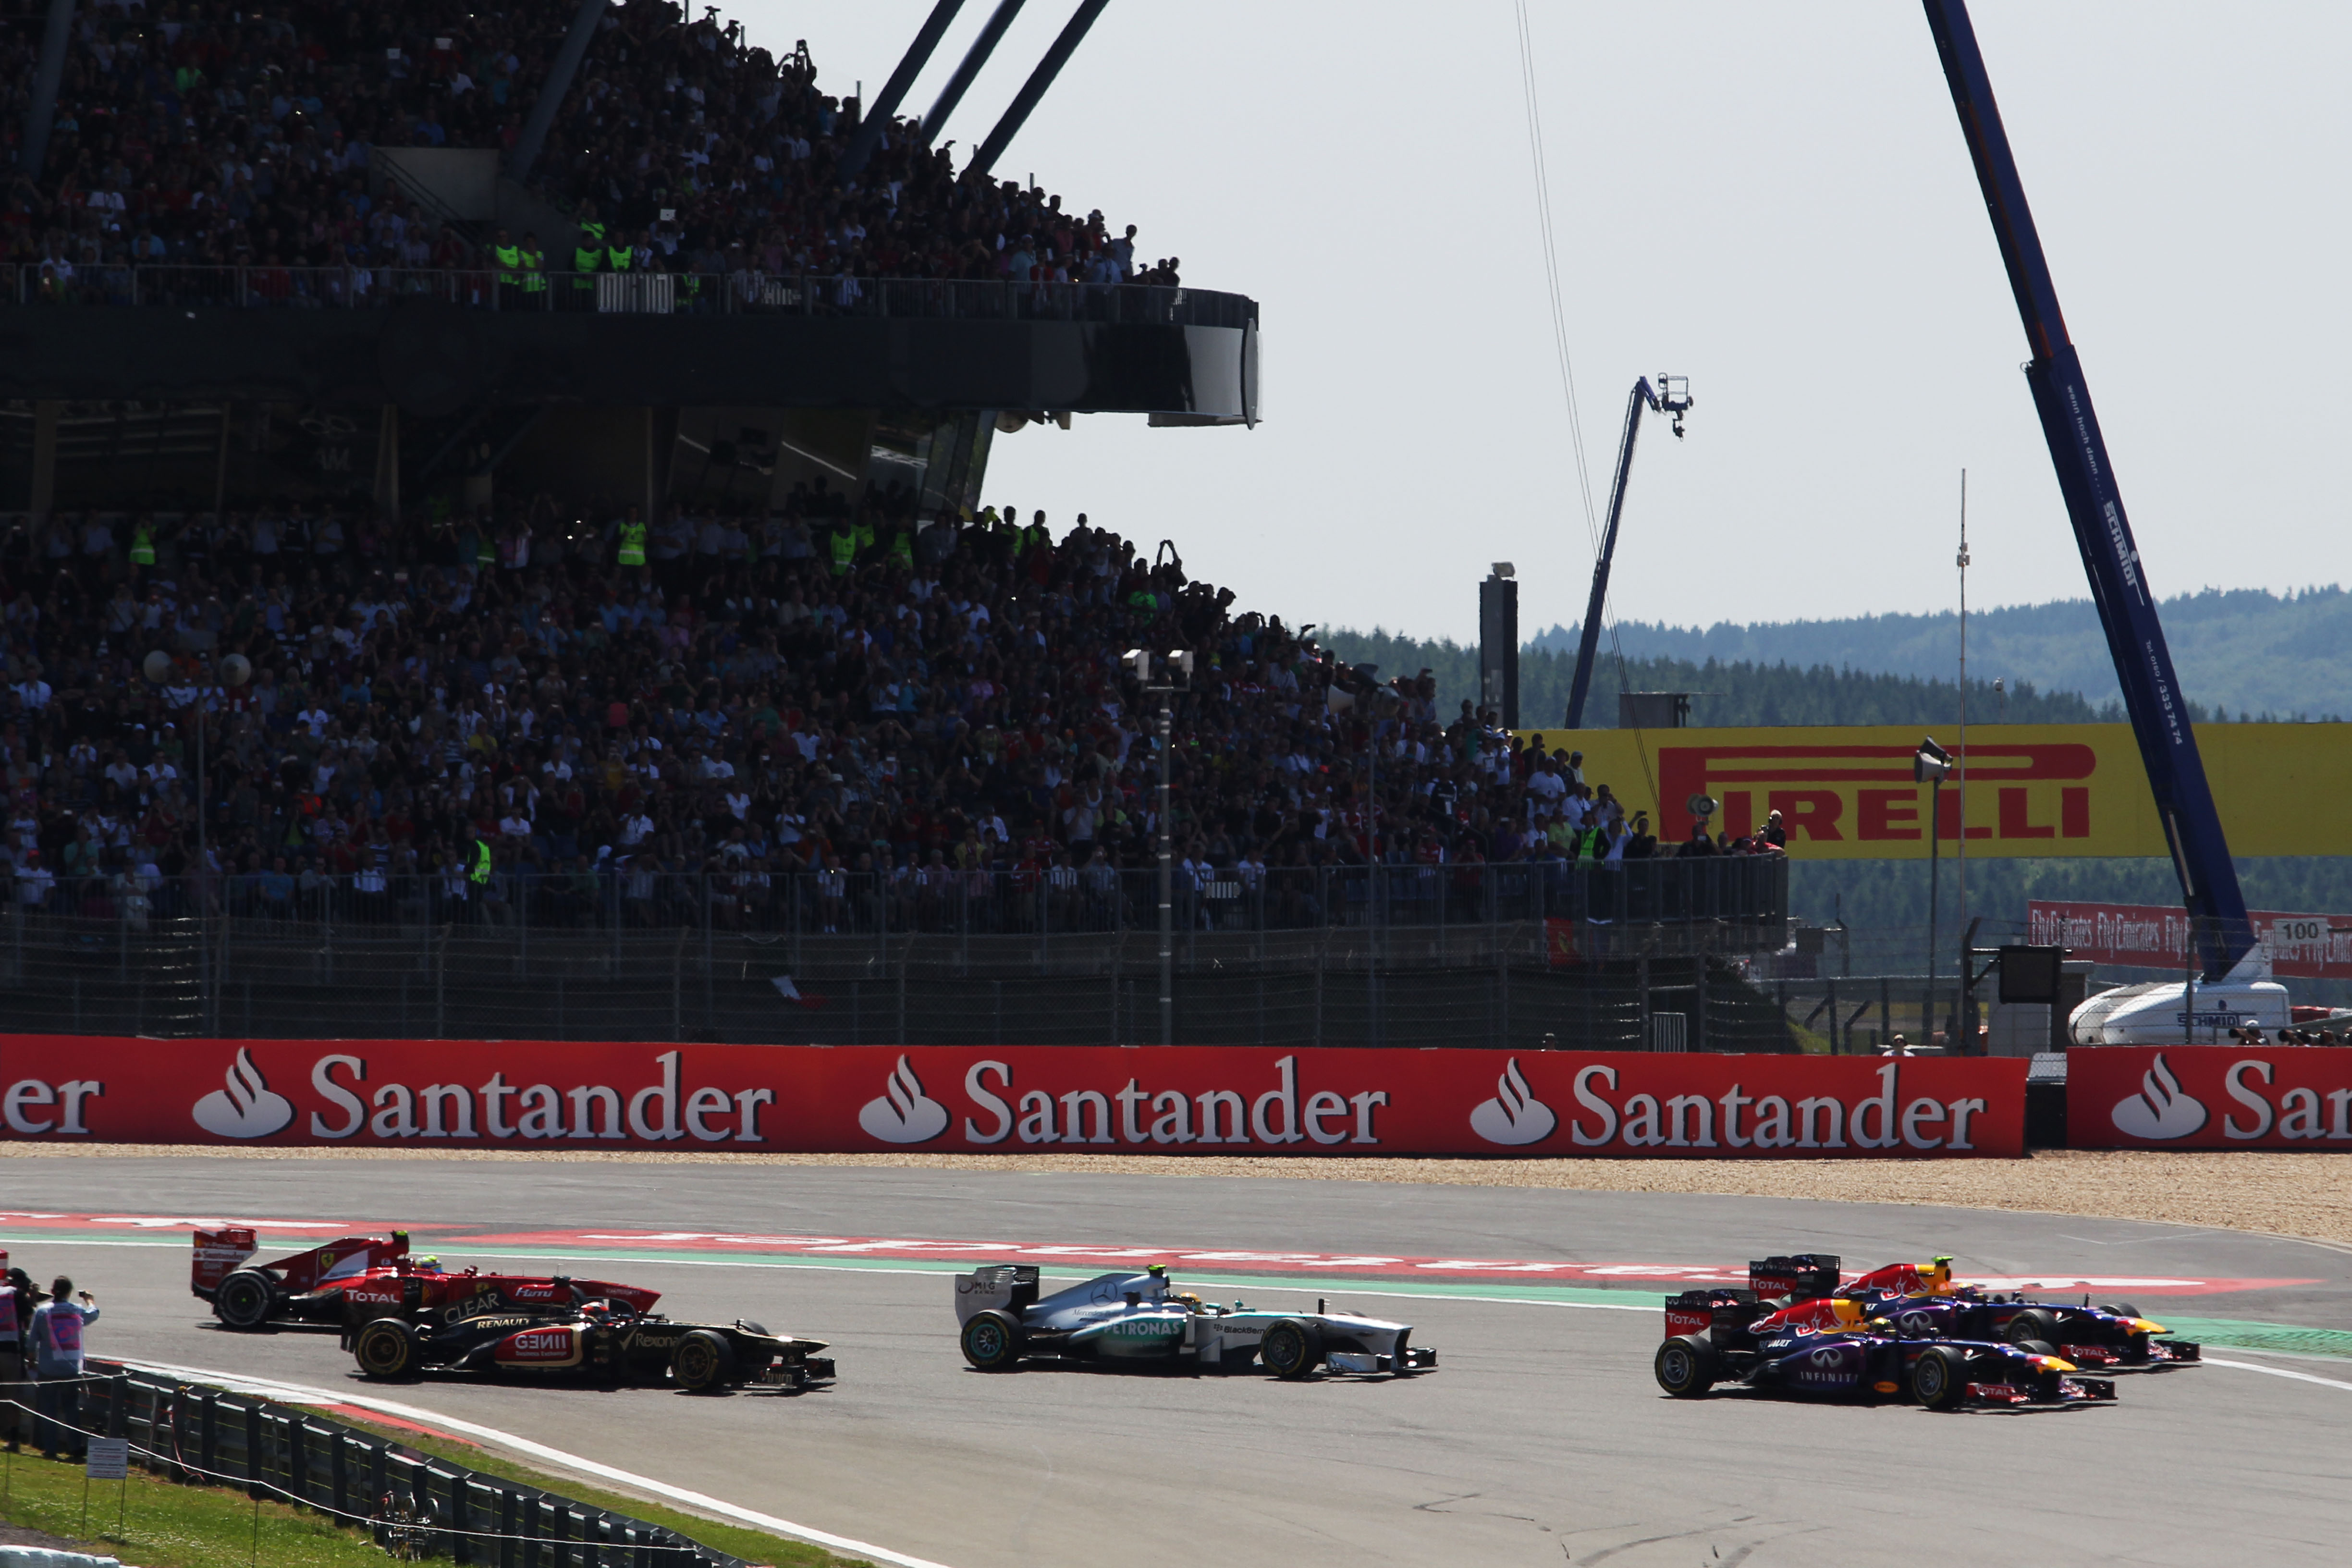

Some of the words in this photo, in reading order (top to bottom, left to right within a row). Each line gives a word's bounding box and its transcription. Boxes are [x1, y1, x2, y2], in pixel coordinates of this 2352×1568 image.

[2067, 385, 2080, 414] wenn
[2076, 416, 2089, 444] hoch
[2086, 447, 2098, 474] dann
[2103, 500, 2138, 588] SCHMIDT
[2145, 639, 2153, 654] Tel.
[2159, 684, 2172, 711] 333
[2167, 713, 2178, 730] 74
[2172, 730, 2183, 746] 74
[1659, 744, 2096, 842] PIRELLI
[2032, 909, 2049, 945] Fly
[2050, 909, 2093, 948] Emirates
[2097, 912, 2116, 959] Fly
[2116, 913, 2160, 953] Emirates
[2165, 915, 2184, 961] Fly
[2283, 922, 2320, 940] 100
[311, 1050, 772, 1141] Santander
[964, 1055, 1386, 1144] Santander
[1571, 1062, 1984, 1149] Santander
[974, 1282, 996, 1290] MIG
[1750, 1278, 1789, 1291] TOTAL
[345, 1289, 401, 1304] TOTAL
[444, 1293, 500, 1323] CLEAR
[476, 1318, 530, 1330] RENAULT
[1666, 1312, 1704, 1326] TOTAL
[1103, 1321, 1180, 1336] PETRONAS
[636, 1334, 680, 1348] Rexona
[1758, 1339, 1792, 1349] RENAULT
[2070, 1345, 2105, 1357] TOTAL
[1800, 1371, 1858, 1383] INFINITI
[1975, 1384, 2009, 1396] TOTAL
